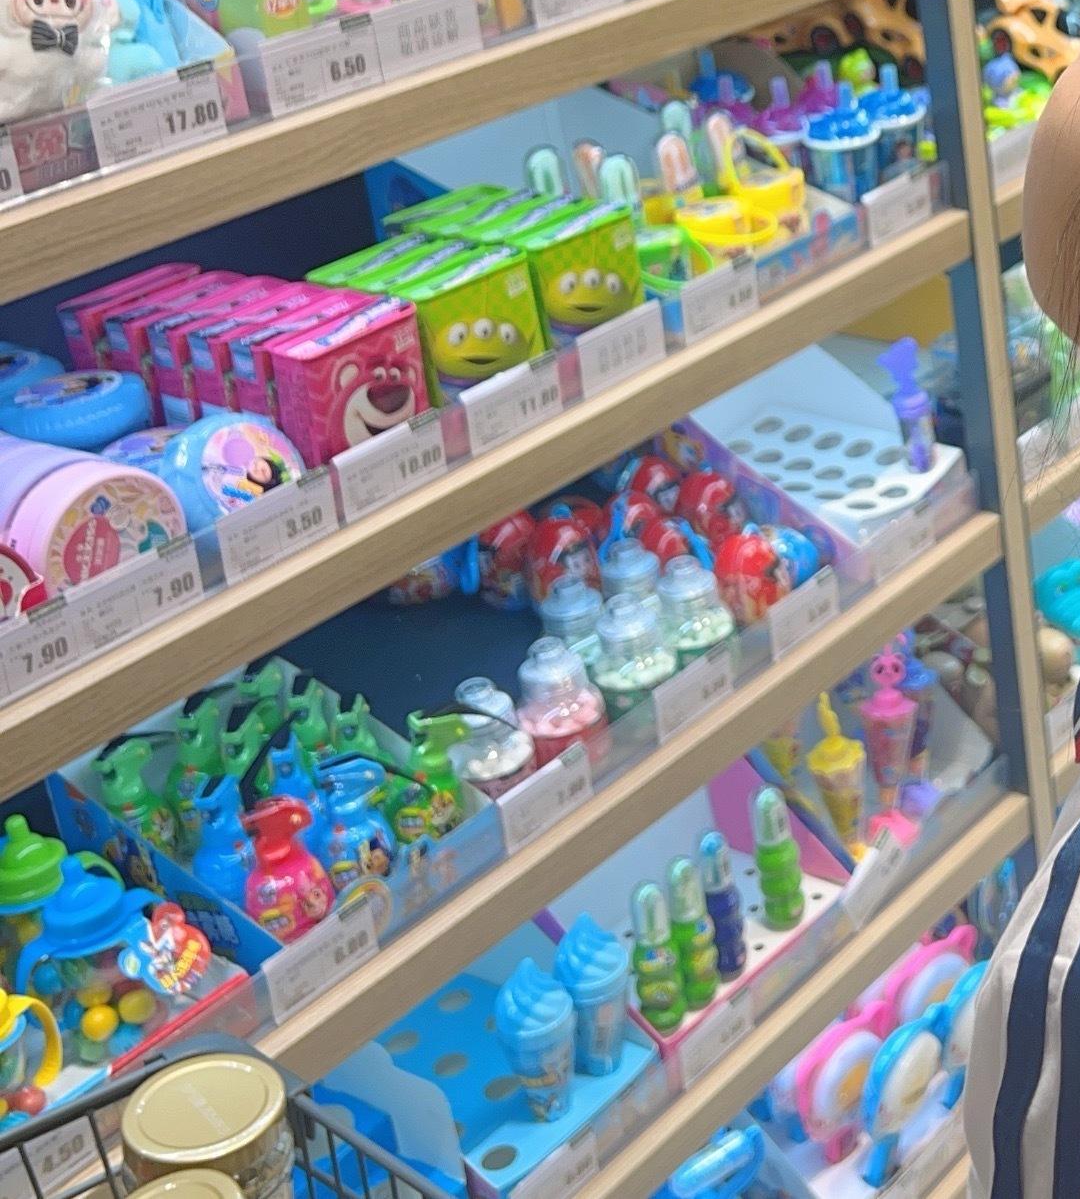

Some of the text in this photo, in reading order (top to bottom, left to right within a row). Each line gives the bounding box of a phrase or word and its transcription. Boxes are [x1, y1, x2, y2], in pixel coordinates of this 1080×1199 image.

[165, 100, 219, 135] 17.80
[153, 571, 195, 607] 7.90
[22, 636, 68, 674] 7.90
